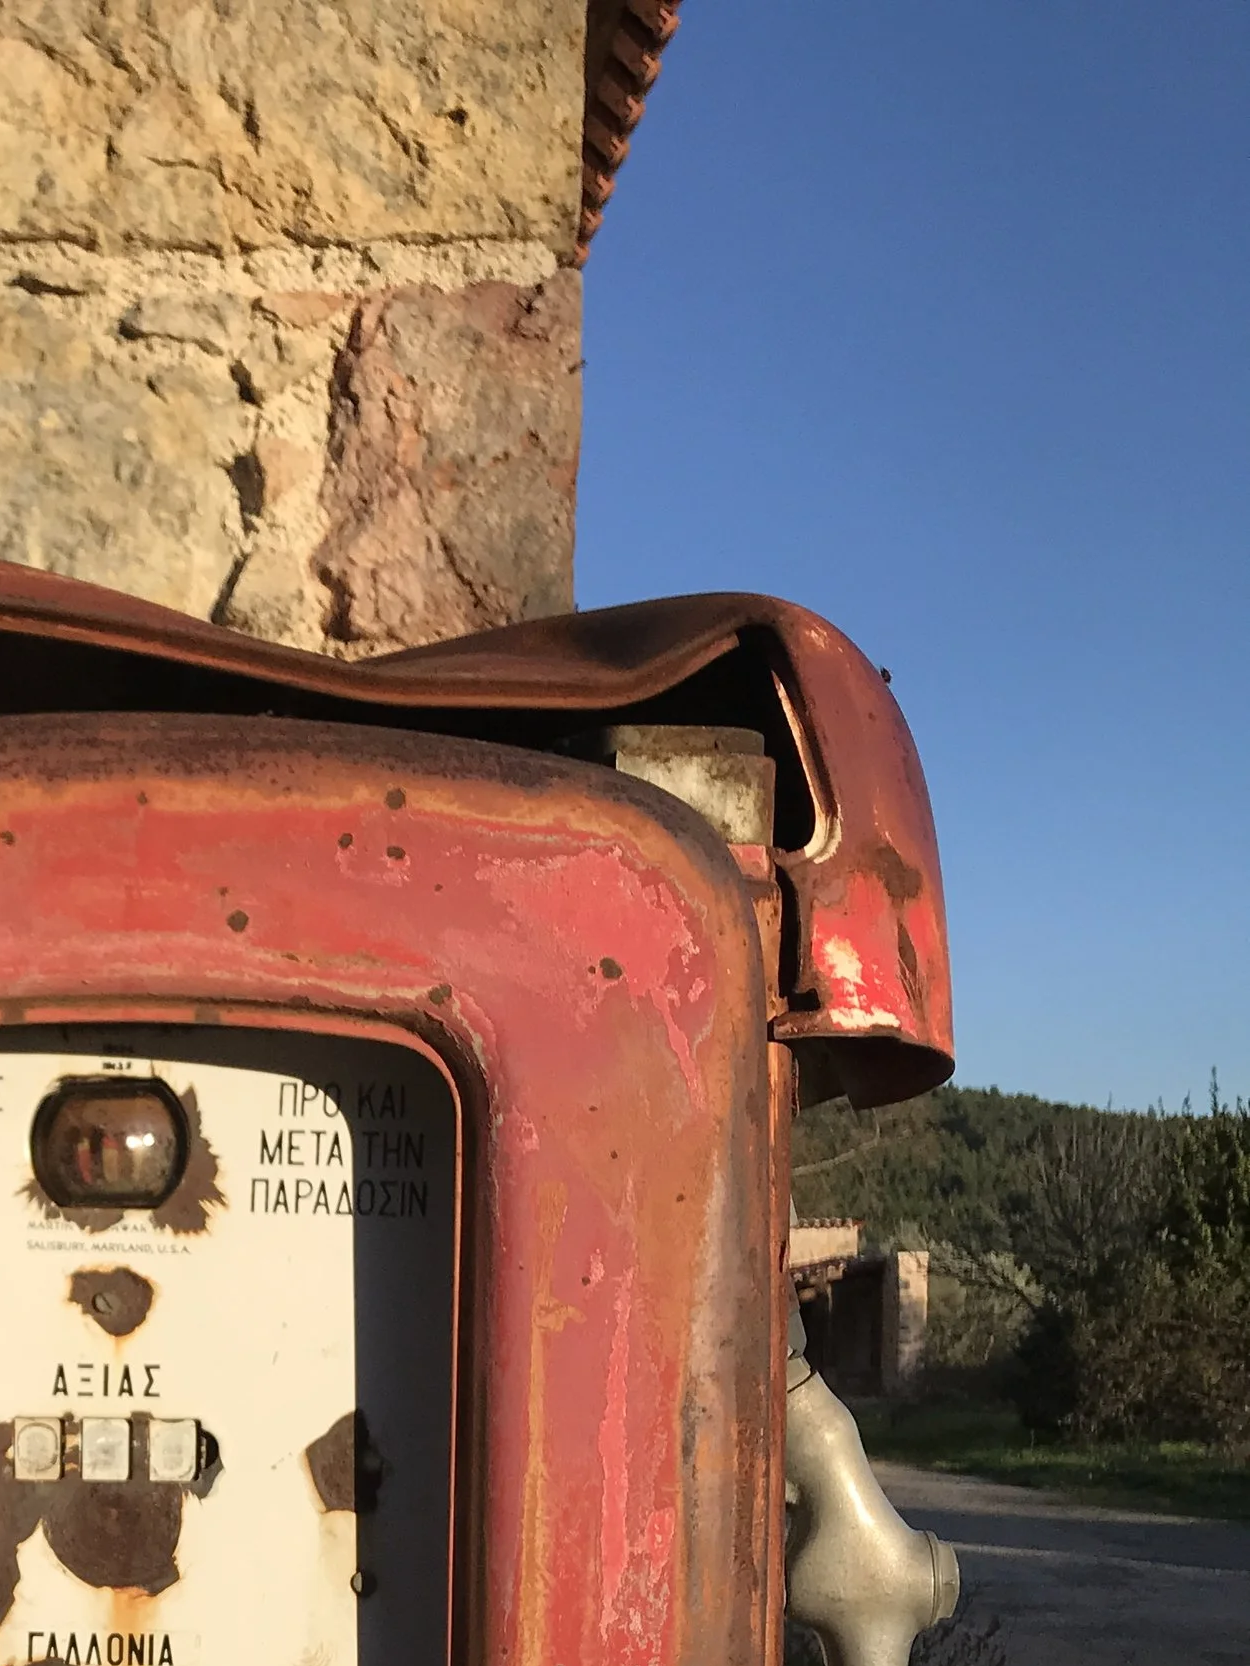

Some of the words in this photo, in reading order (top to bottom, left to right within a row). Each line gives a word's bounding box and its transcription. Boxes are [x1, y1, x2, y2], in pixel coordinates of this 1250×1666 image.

[279, 1081, 342, 1118] ΠΡΟ
[358, 1082, 406, 1119] ΚΑΙ
[260, 1129, 344, 1166] ΜΕΤΑ
[362, 1131, 425, 1169] ΤΗΝ
[250, 1178, 428, 1218] ΠΑΡΑΔΟΣΙΝ
[26, 1239, 88, 1252] SALISBURY,
[91, 1242, 154, 1254] MARYLAND,
[52, 1363, 160, 1397] ΑΞΙΑΣ
[28, 1632, 174, 1666] ΓΑΛΛΟΝΙΑ
